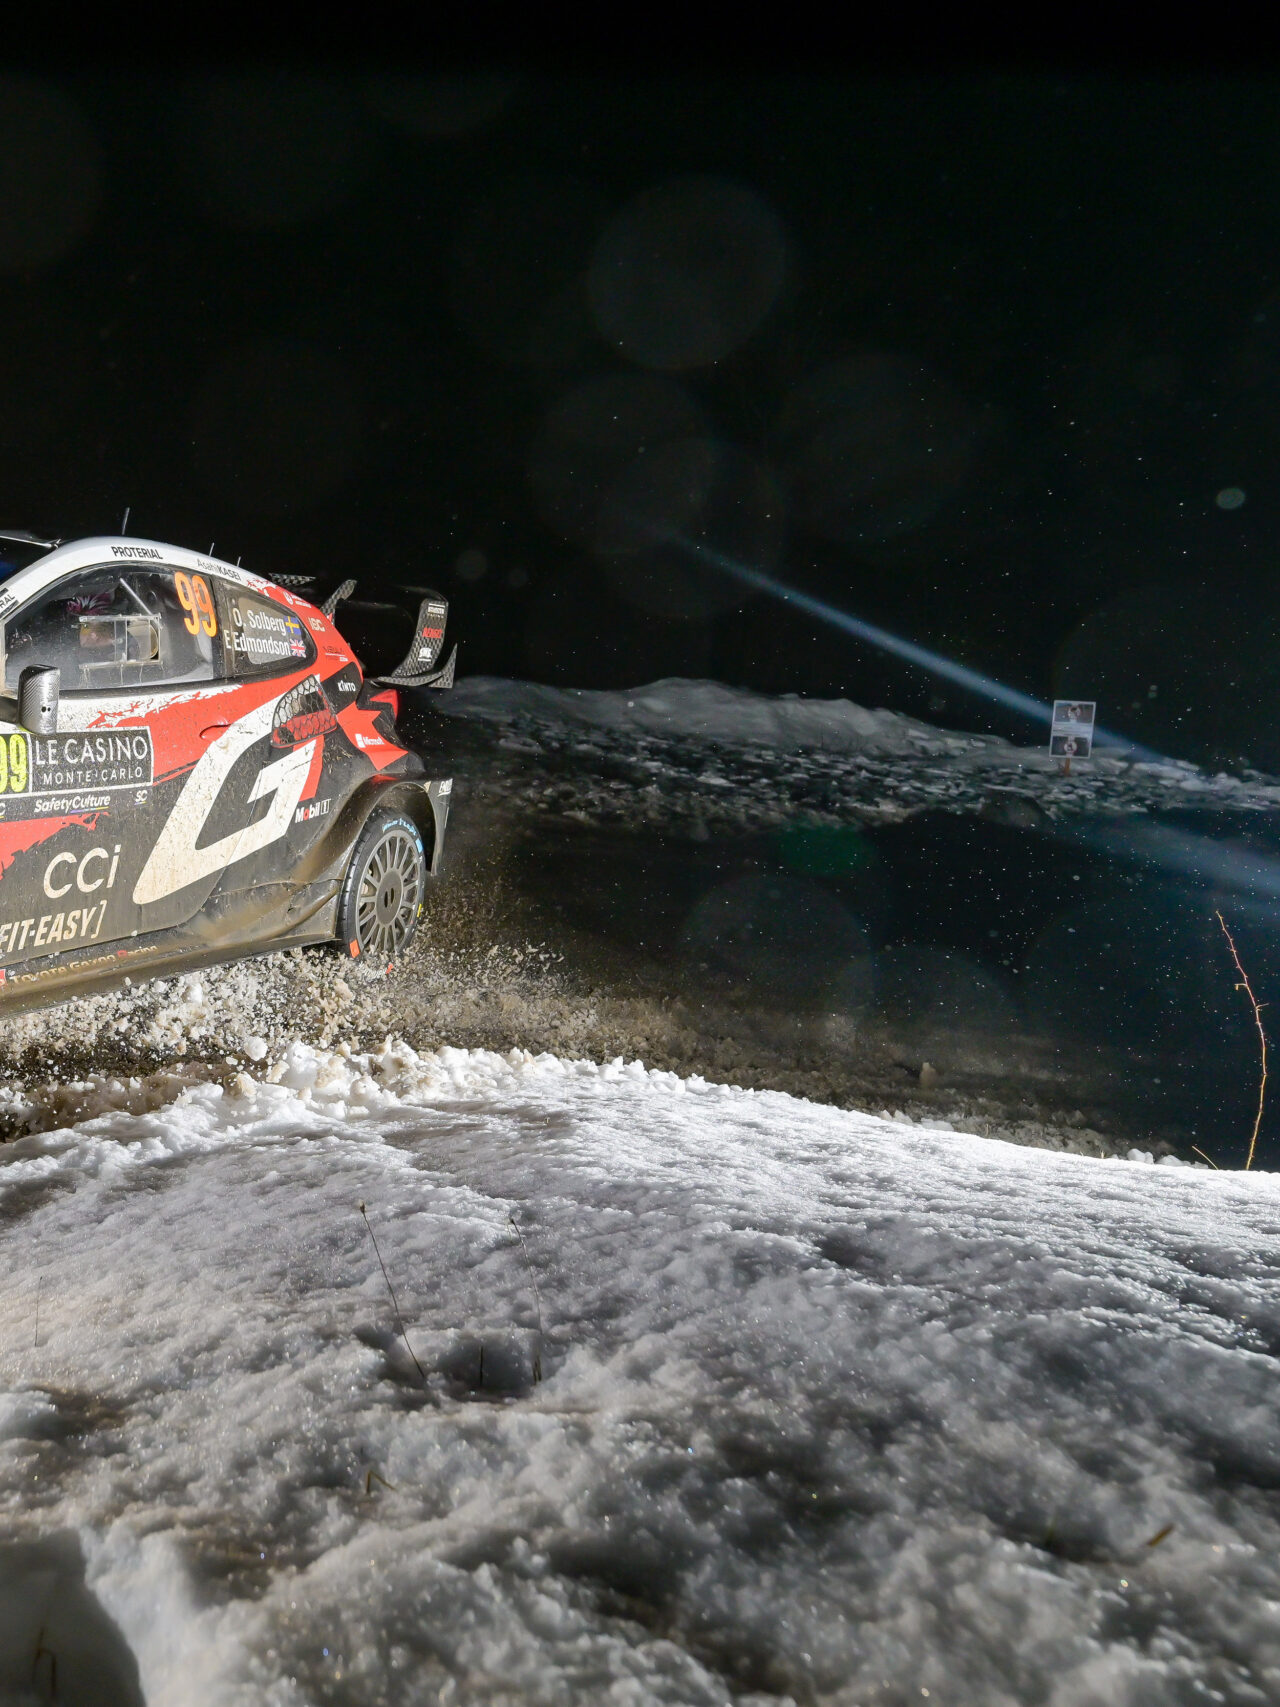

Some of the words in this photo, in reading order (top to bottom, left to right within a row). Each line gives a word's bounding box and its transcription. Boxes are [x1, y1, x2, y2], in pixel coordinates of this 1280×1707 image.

[111, 545, 164, 561] PROTERIAL
[173, 571, 218, 638] 99
[247, 609, 287, 637] Solberg
[234, 630, 292, 656] Edmondson
[35, 738, 59, 766] LE
[65, 735, 149, 765] CASINO
[34, 794, 111, 814] SafetyCulture
[294, 801, 321, 824] Mobil
